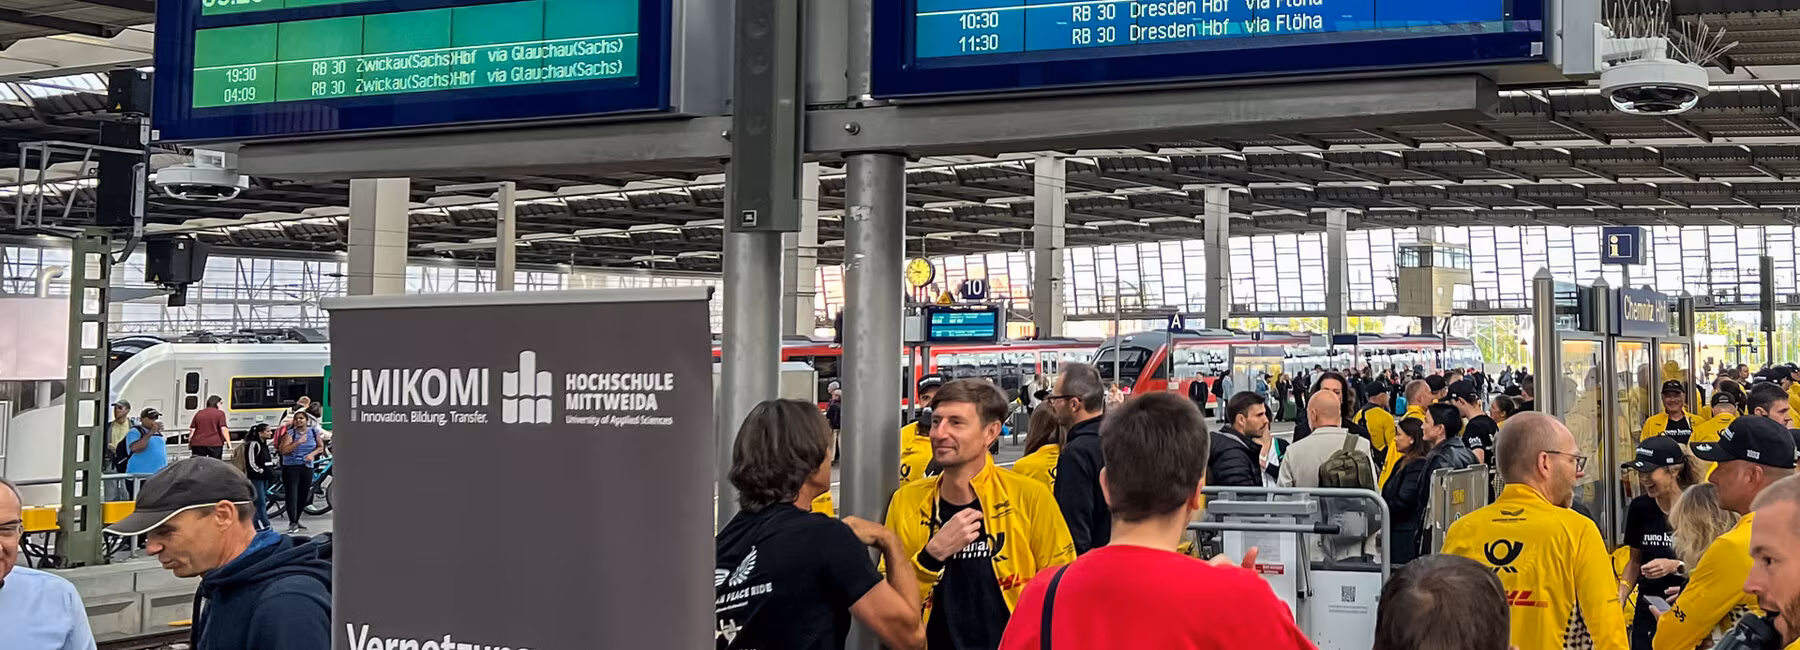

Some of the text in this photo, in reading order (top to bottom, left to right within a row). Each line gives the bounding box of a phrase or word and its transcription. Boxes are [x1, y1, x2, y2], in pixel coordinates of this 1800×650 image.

[1072, 5, 1091, 23] RB
[1097, 2, 1116, 21] 30
[1130, 0, 1196, 19] Dresden
[1202, 0, 1229, 13] Hbf
[959, 12, 999, 31] 10:30
[1072, 14, 1323, 45] RB 30 Dresden Hbf via Flöha
[959, 33, 999, 52] 11:30
[312, 61, 327, 76] RB
[332, 59, 346, 75] 30
[488, 47, 508, 63] via
[511, 38, 624, 62] Glauchau(Sachs)
[226, 67, 257, 83] 19:30
[312, 81, 327, 96] RB
[331, 80, 345, 95] 30
[487, 68, 508, 83] via
[511, 59, 623, 83] Glauchau(Sachs)
[224, 87, 256, 103] 04:09
[965, 279, 982, 296] 10
[1624, 294, 1655, 322] Chemnitz
[1171, 315, 1181, 329] A
[361, 368, 489, 406] MIKOMI
[565, 373, 674, 391] HOCHSCHULE
[565, 393, 658, 411] MITTWEIDA
[361, 410, 489, 426] Innovation. Bildung. Transfer.
[565, 414, 673, 427] University of Applied Sciences
[750, 582, 773, 596] RIDE
